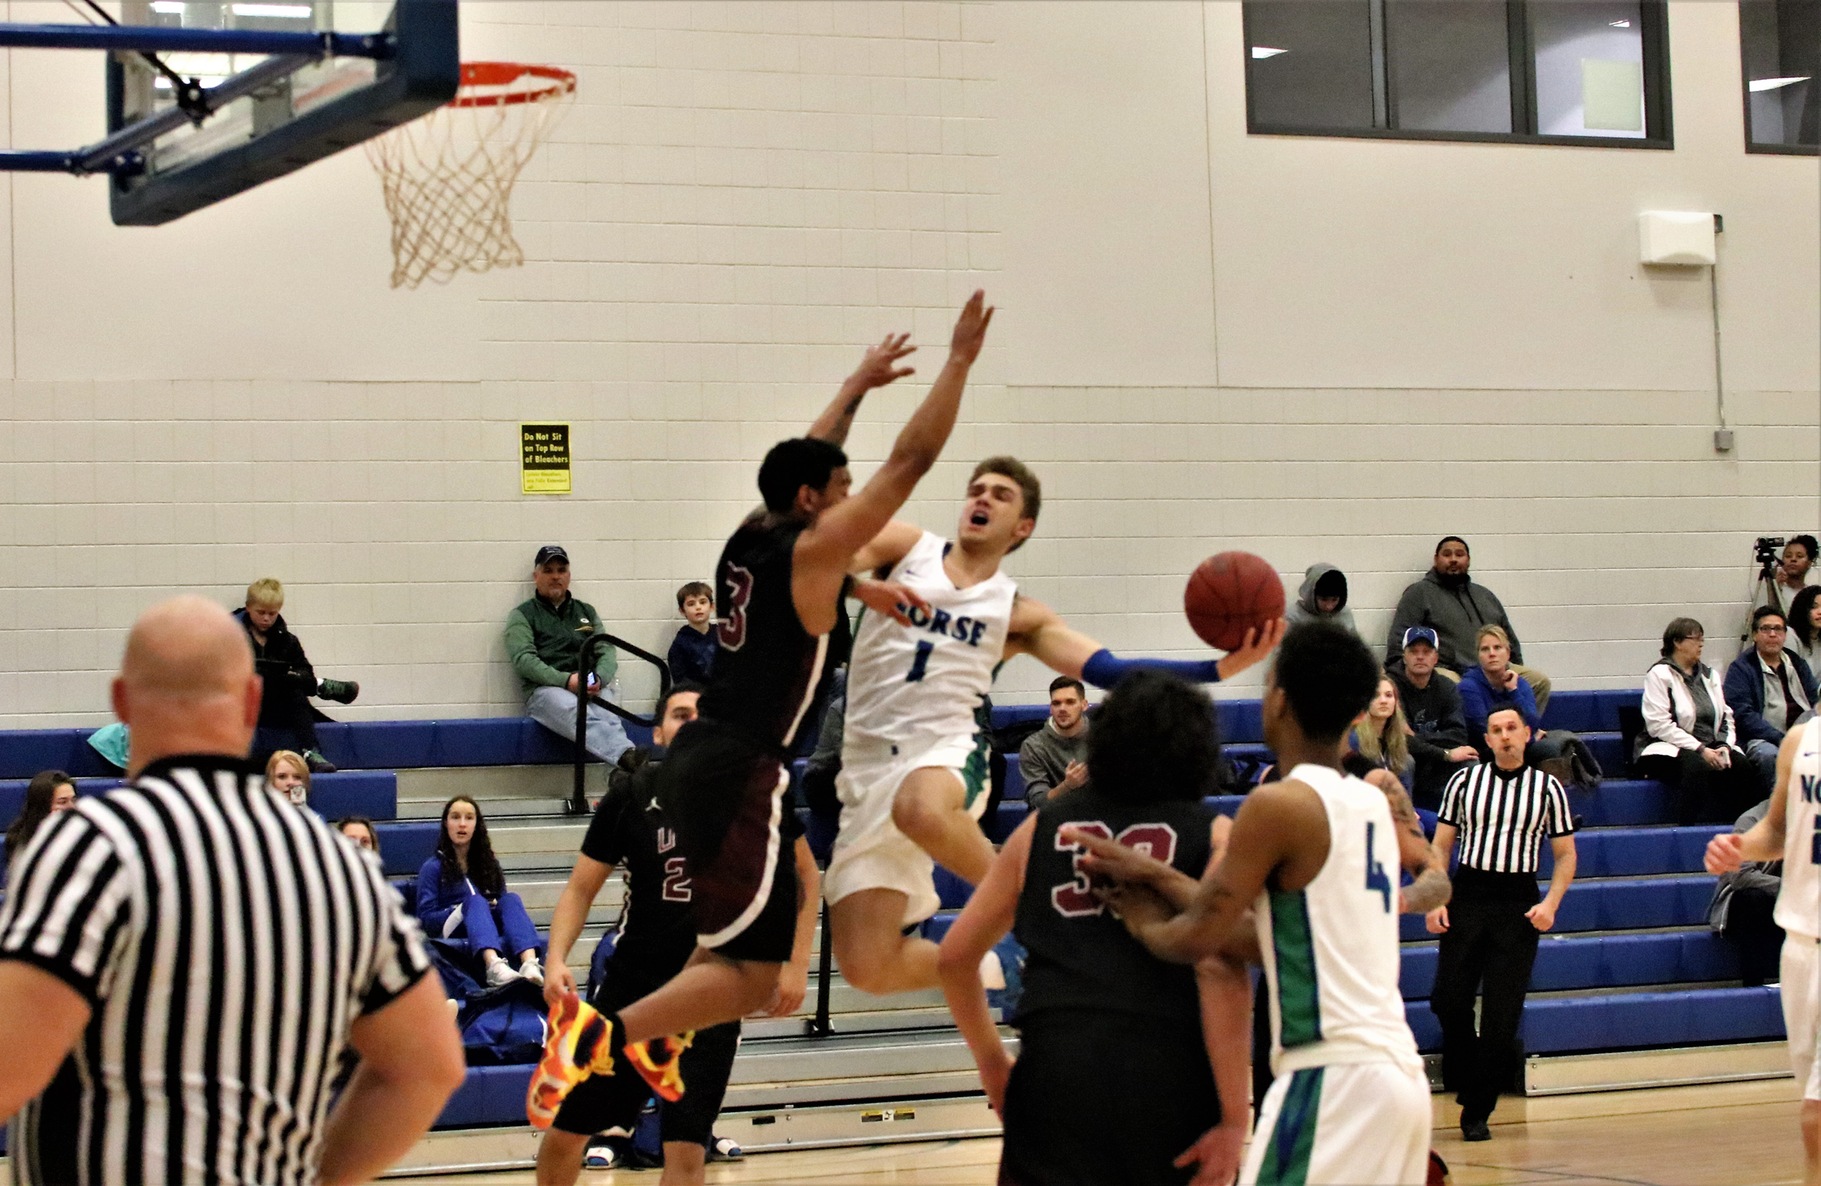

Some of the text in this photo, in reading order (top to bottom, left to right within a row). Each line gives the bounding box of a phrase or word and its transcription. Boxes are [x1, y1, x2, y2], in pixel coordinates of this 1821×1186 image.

[525, 455, 568, 463] of Bleachers
[535, 444, 548, 453] Top
[550, 444, 564, 452] Row
[717, 561, 754, 652] 3
[896, 603, 987, 647] ORSE
[906, 640, 934, 682] 1
[662, 857, 692, 902] 2
[1366, 821, 1391, 913] 4
